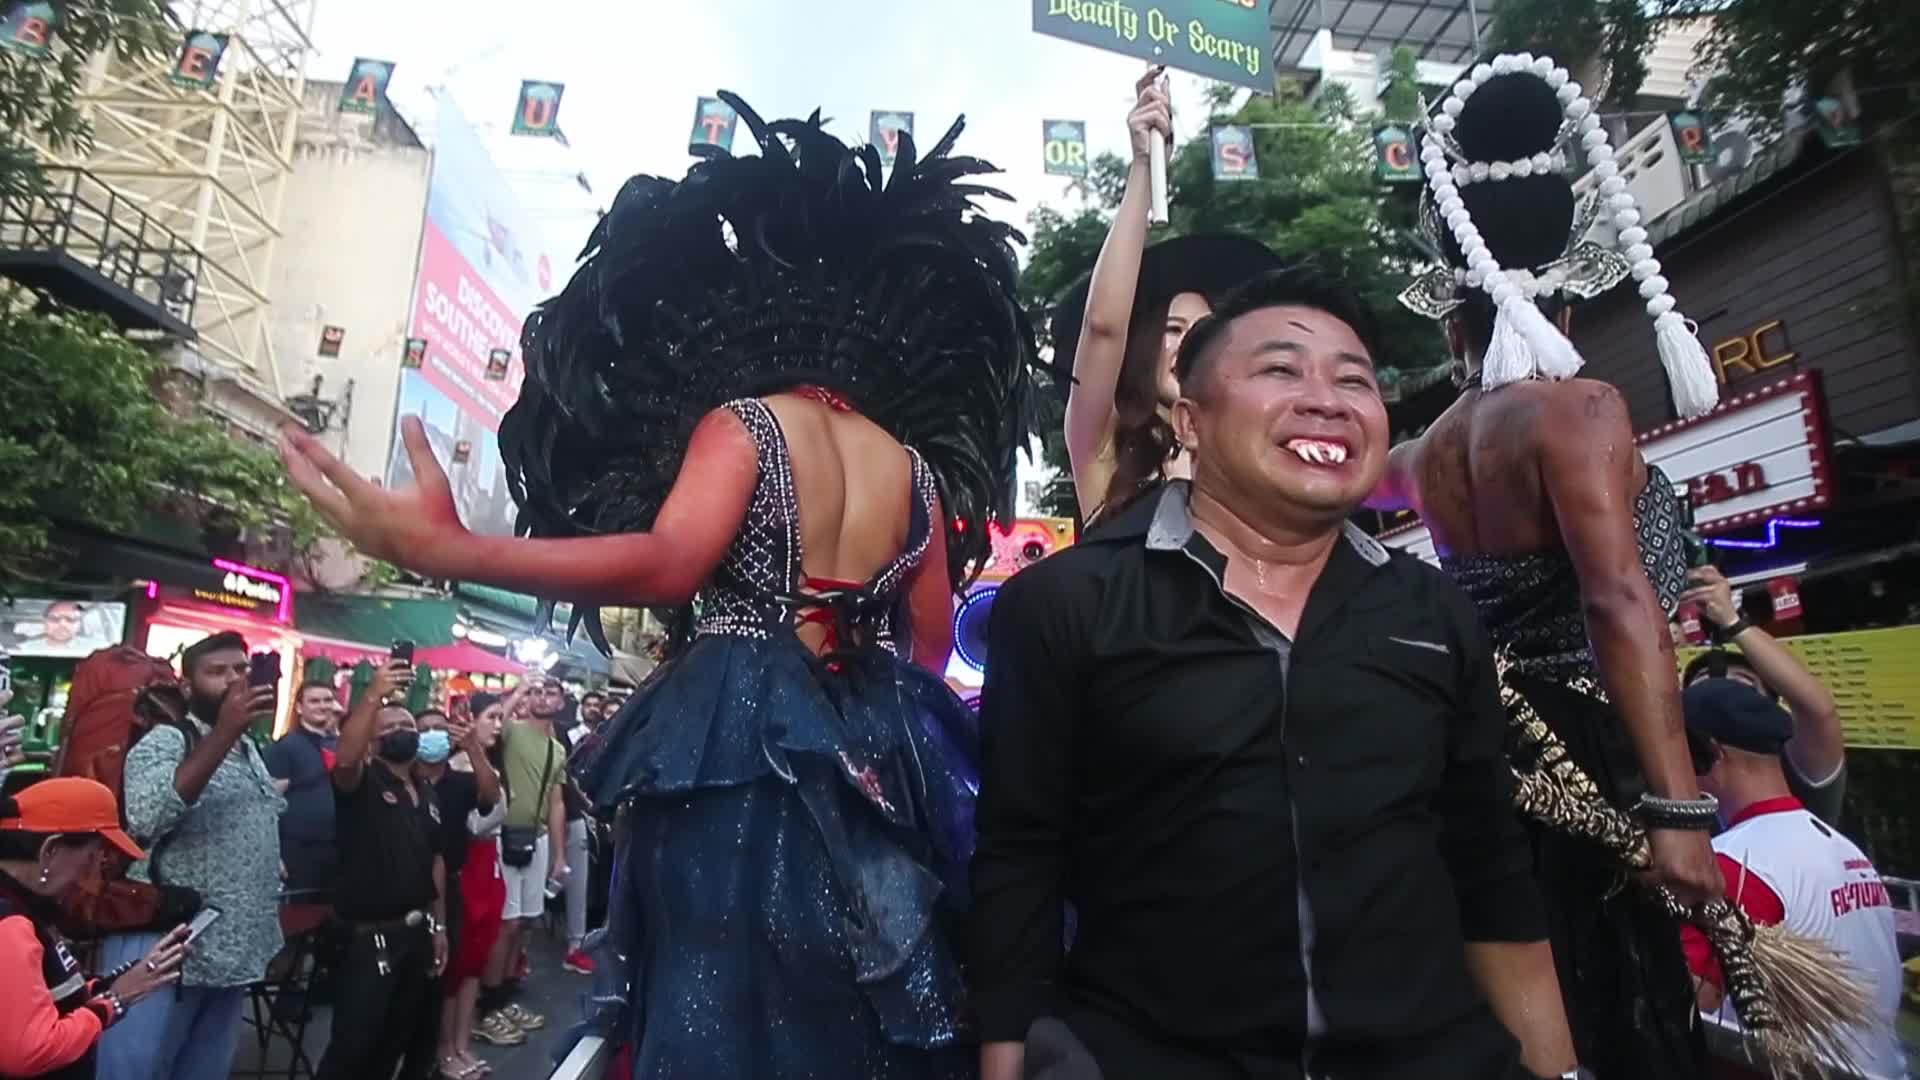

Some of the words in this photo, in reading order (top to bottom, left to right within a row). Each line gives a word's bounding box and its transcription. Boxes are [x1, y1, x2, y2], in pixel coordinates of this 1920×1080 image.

[16, 17, 48, 48] B
[180, 47, 211, 81] E
[353, 74, 376, 103] A
[524, 95, 552, 128] U
[702, 115, 728, 145] T
[1046, 141, 1087, 166] OR
[1221, 143, 1251, 171] S
[1385, 142, 1412, 169] C
[1681, 127, 1704, 153] R
[1147, 8, 1179, 47] Or
[1188, 19, 1260, 76] Scary
